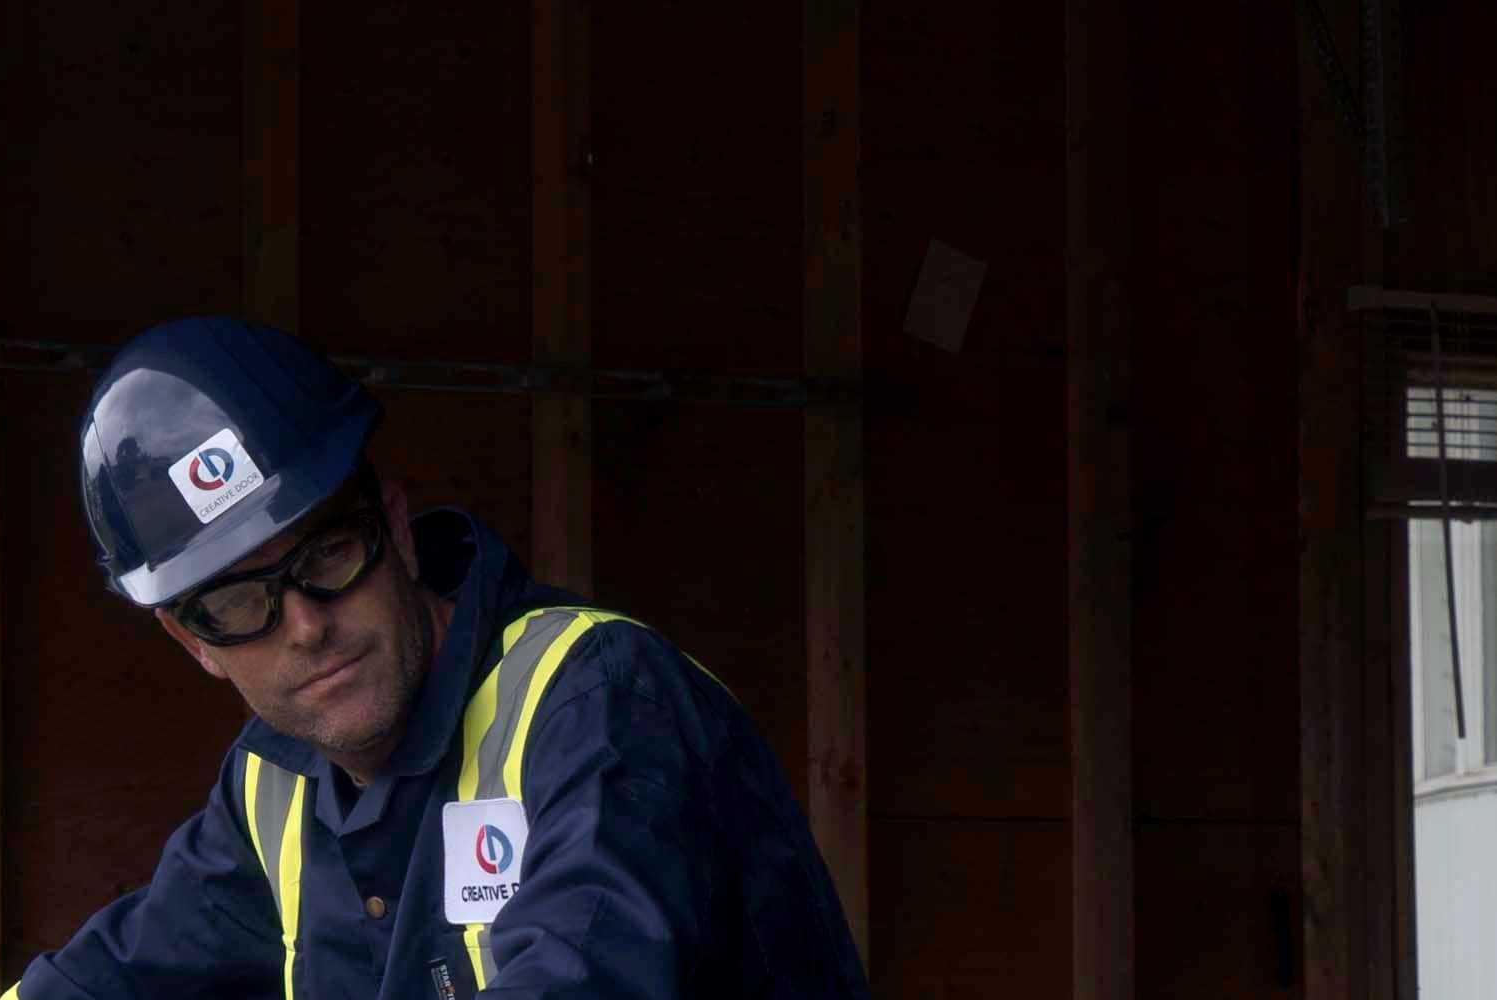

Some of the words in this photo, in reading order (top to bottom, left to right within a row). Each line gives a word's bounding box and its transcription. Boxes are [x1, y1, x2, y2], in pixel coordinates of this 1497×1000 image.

[199, 490, 234, 518] CREATIVE
[234, 472, 261, 494] DOOR
[461, 883, 509, 902] CREATIVE
